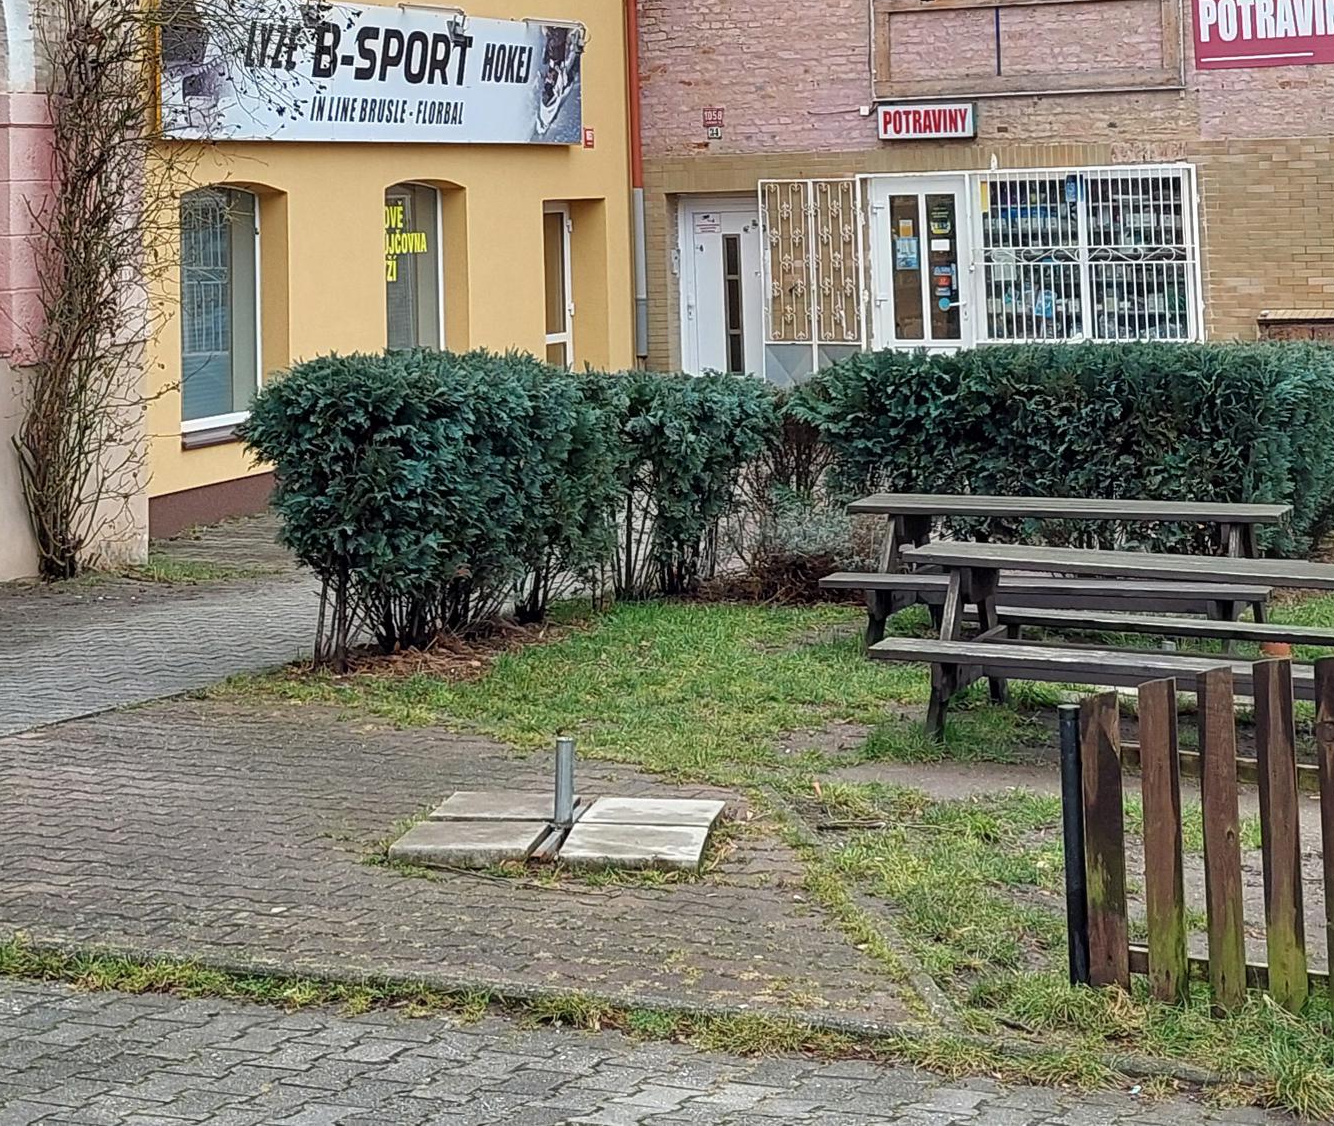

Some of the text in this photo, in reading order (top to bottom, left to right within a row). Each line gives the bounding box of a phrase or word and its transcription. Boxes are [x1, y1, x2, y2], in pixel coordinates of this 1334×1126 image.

[311, 21, 473, 86] B-SPORT
[481, 42, 534, 84] HOKEJ
[310, 96, 326, 122] IN
[327, 96, 357, 122] LINE
[359, 97, 408, 124] BRUSLE
[415, 99, 464, 125] FLORBAL
[704, 110, 723, 121] 1058
[883, 108, 968, 135] POTRAVINY
